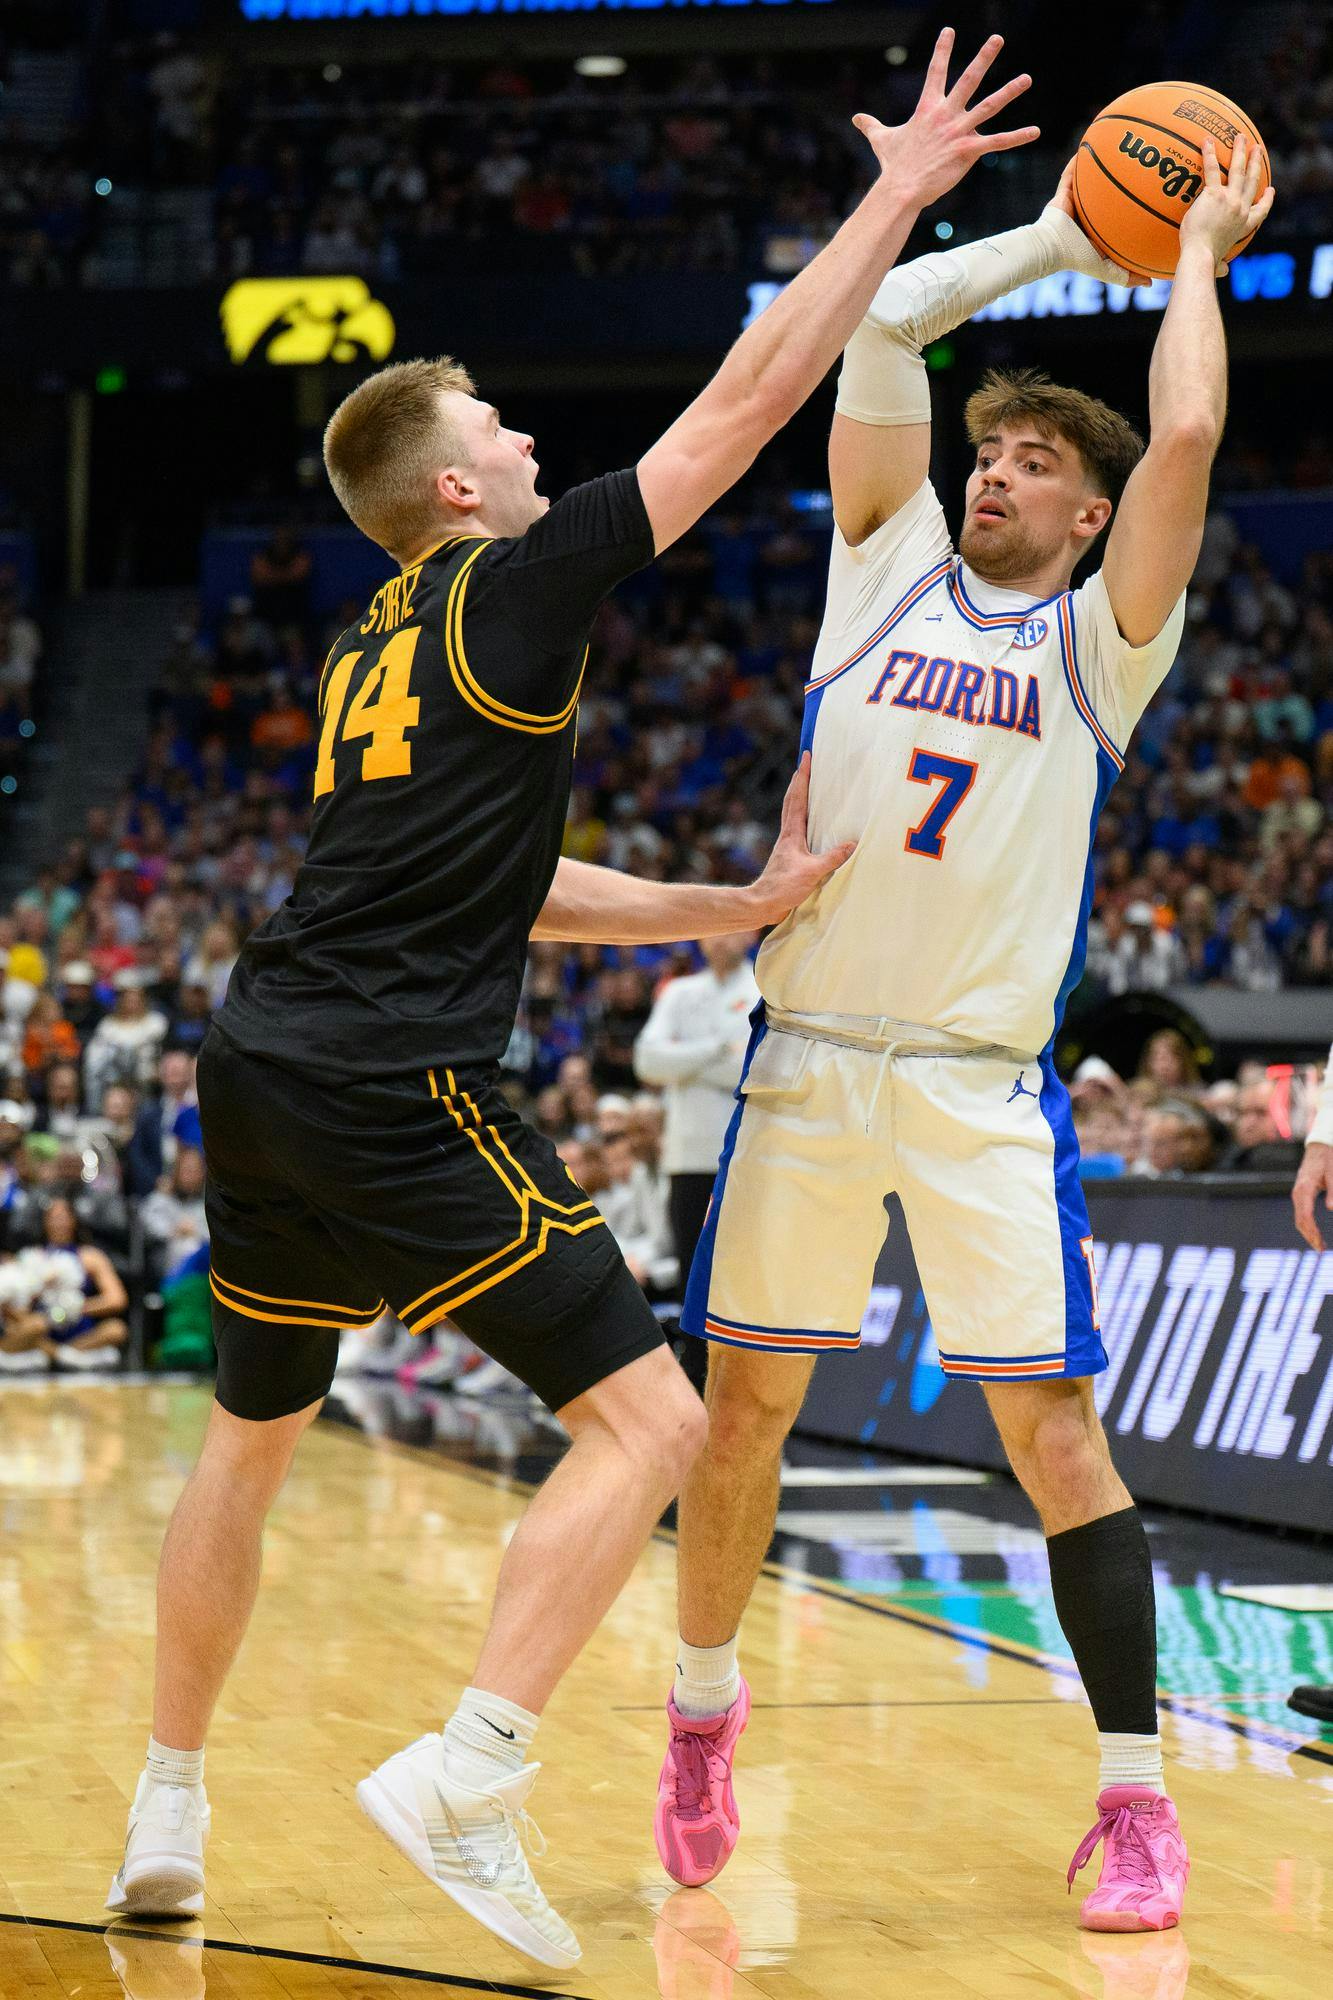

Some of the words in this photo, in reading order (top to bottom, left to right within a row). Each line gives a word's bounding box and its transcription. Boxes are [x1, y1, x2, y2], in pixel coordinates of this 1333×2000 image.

[1118, 131, 1203, 204] ilson
[1166, 147, 1184, 160] NXT
[313, 625, 422, 804] 14
[904, 747, 979, 861] 7
[1116, 1244, 1236, 1443] TO
[1193, 1247, 1333, 1460] THE
